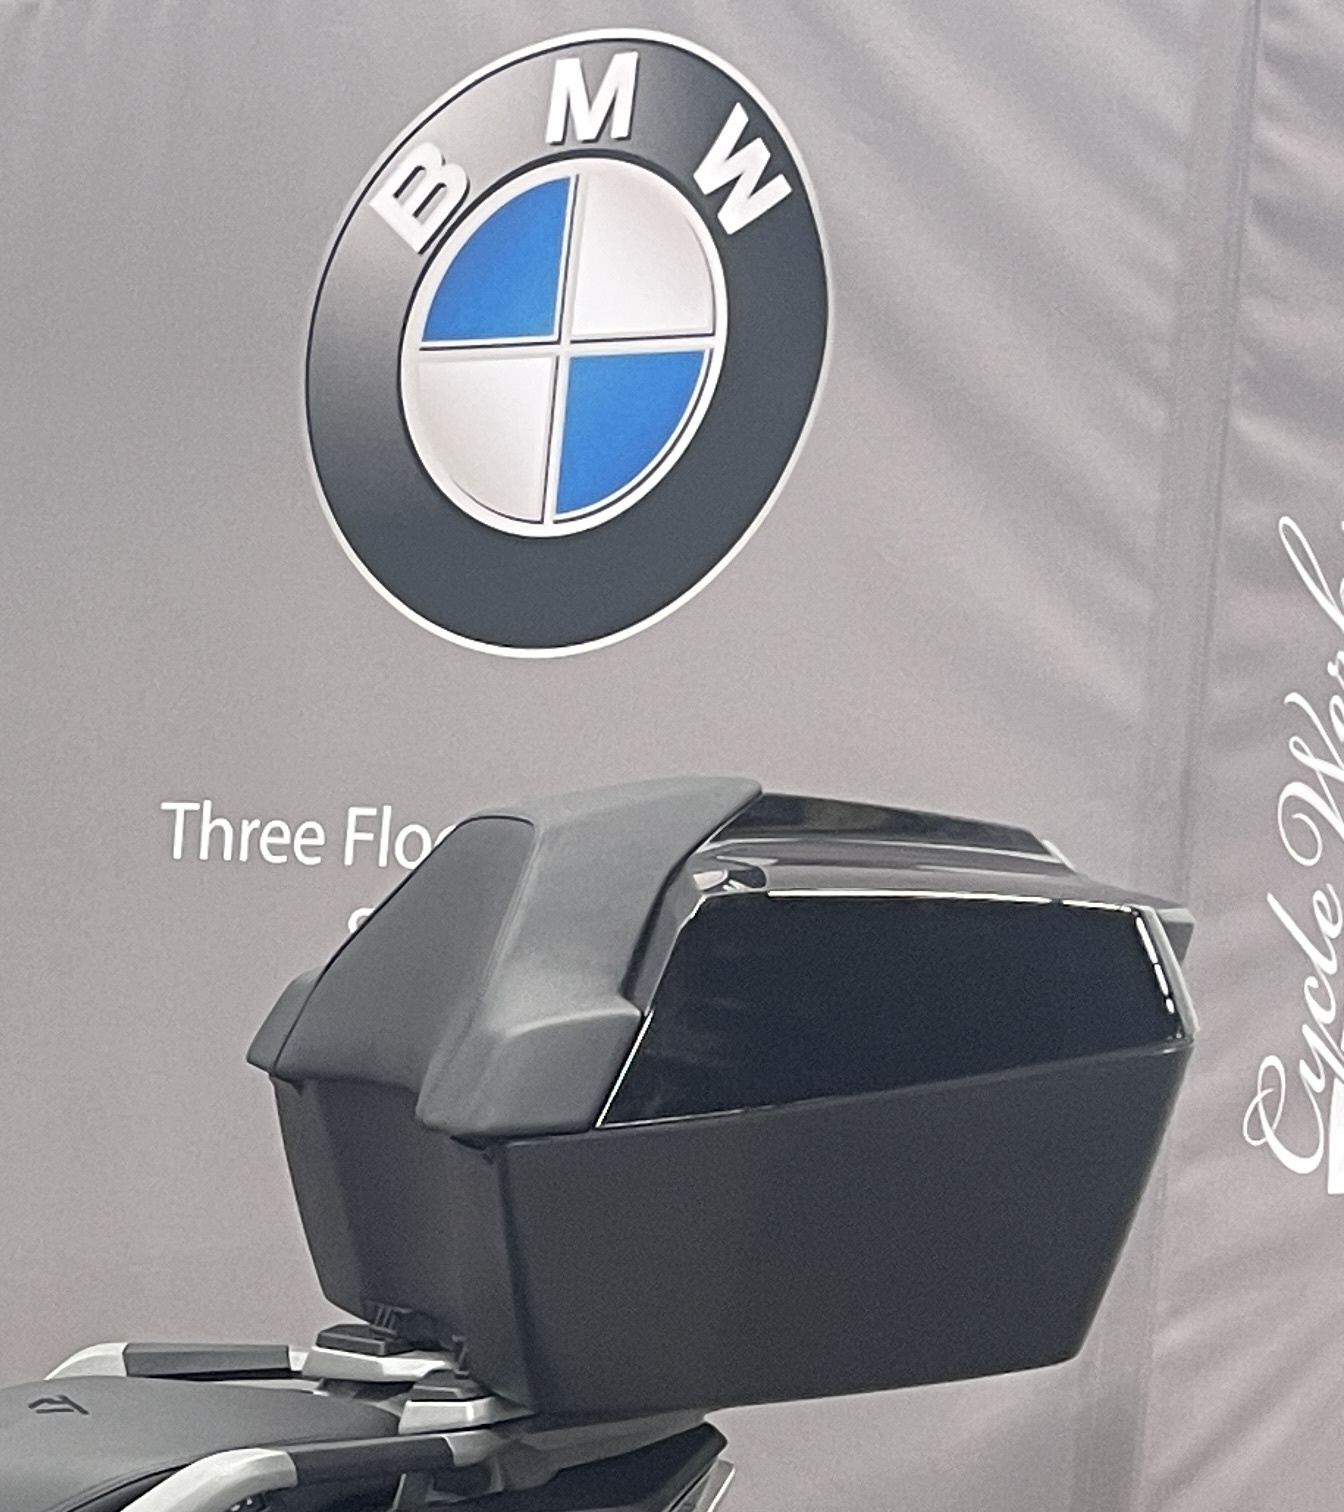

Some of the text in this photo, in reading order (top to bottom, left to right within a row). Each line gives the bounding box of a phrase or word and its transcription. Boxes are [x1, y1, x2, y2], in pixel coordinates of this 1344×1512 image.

[368, 51, 792, 254] BMW
[159, 798, 458, 870] Three Flo
